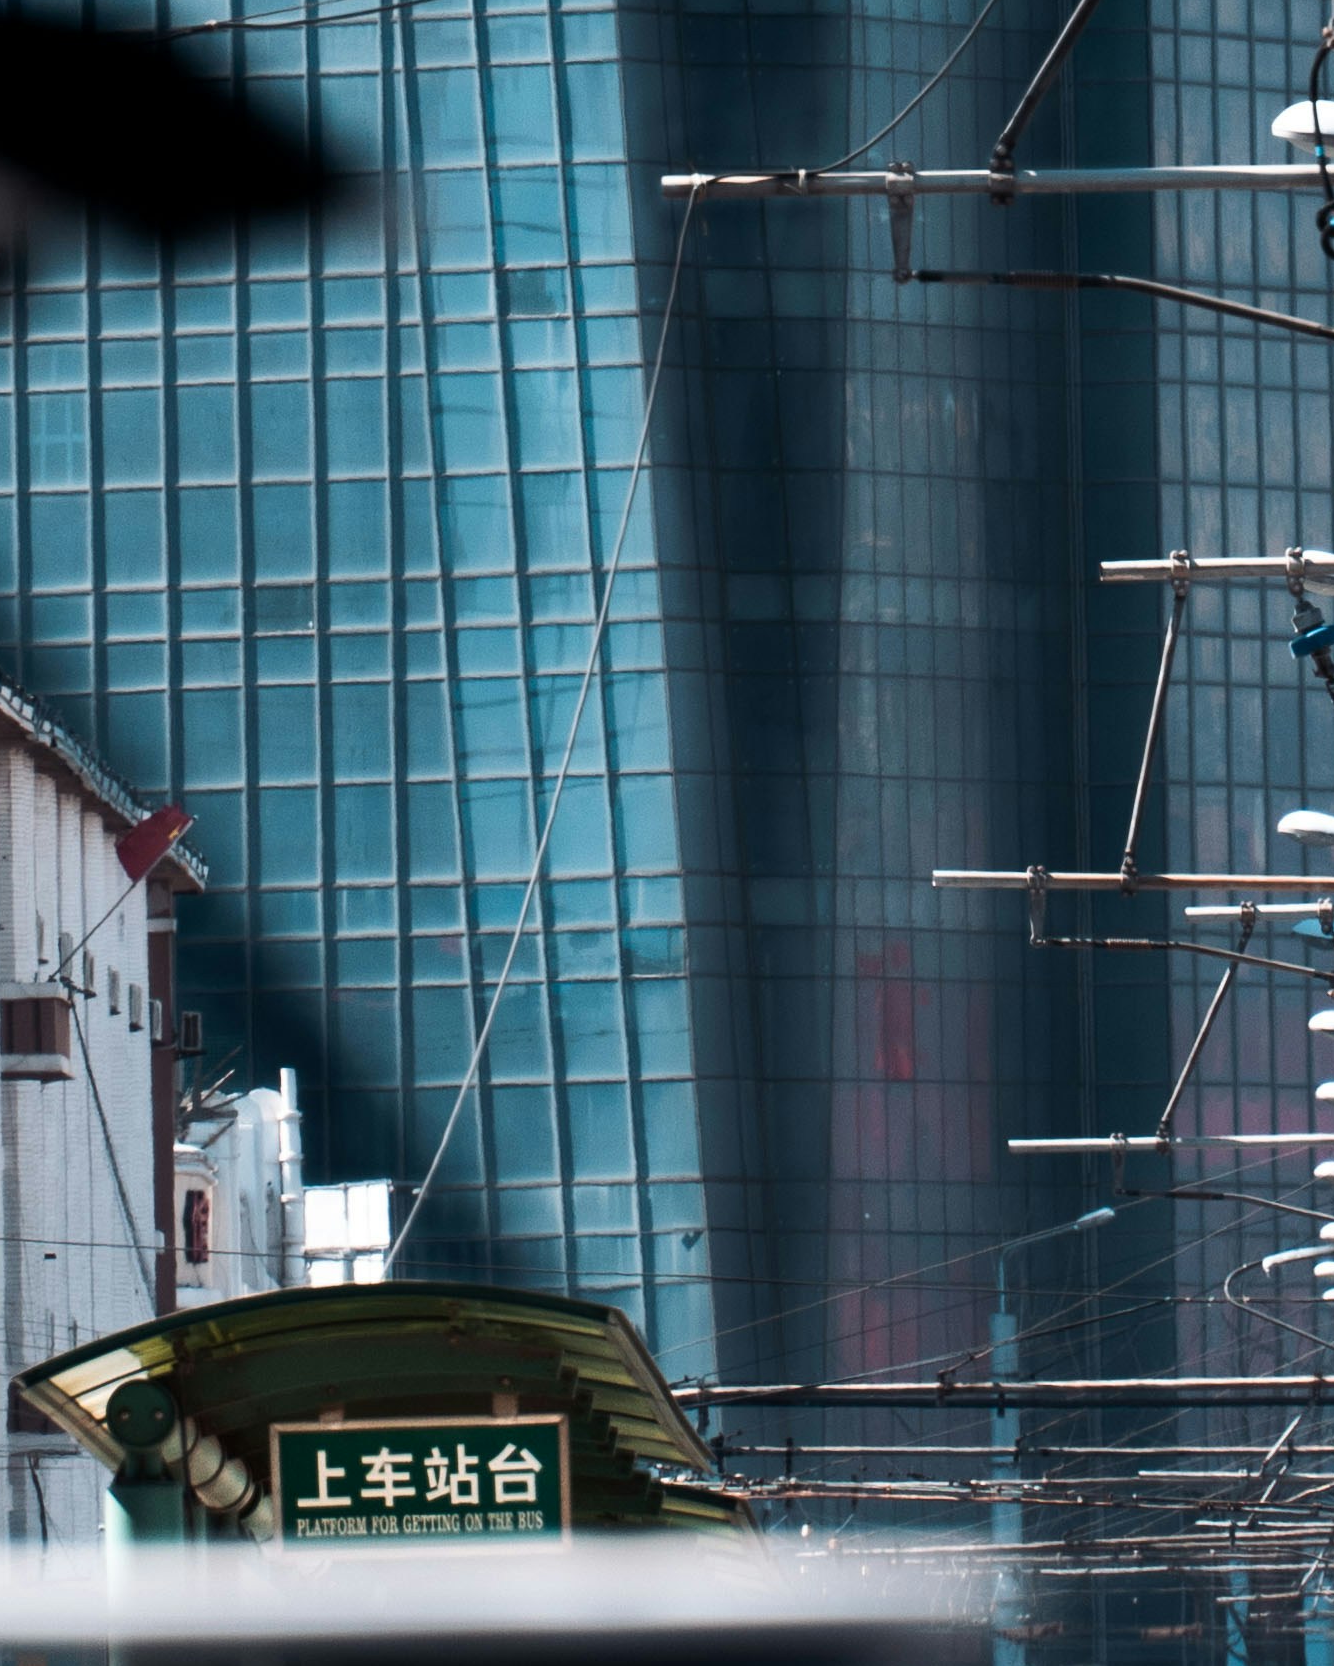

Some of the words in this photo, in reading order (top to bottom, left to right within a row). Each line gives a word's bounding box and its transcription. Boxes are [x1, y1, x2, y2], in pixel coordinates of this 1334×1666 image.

[297, 1442, 544, 1509] 上车站台
[297, 1515, 367, 1537] PLATFORM
[371, 1514, 398, 1535] FOR
[402, 1512, 460, 1534] GETTING
[464, 1512, 484, 1531] ON
[487, 1511, 514, 1530] THE
[517, 1509, 544, 1530] BUS
